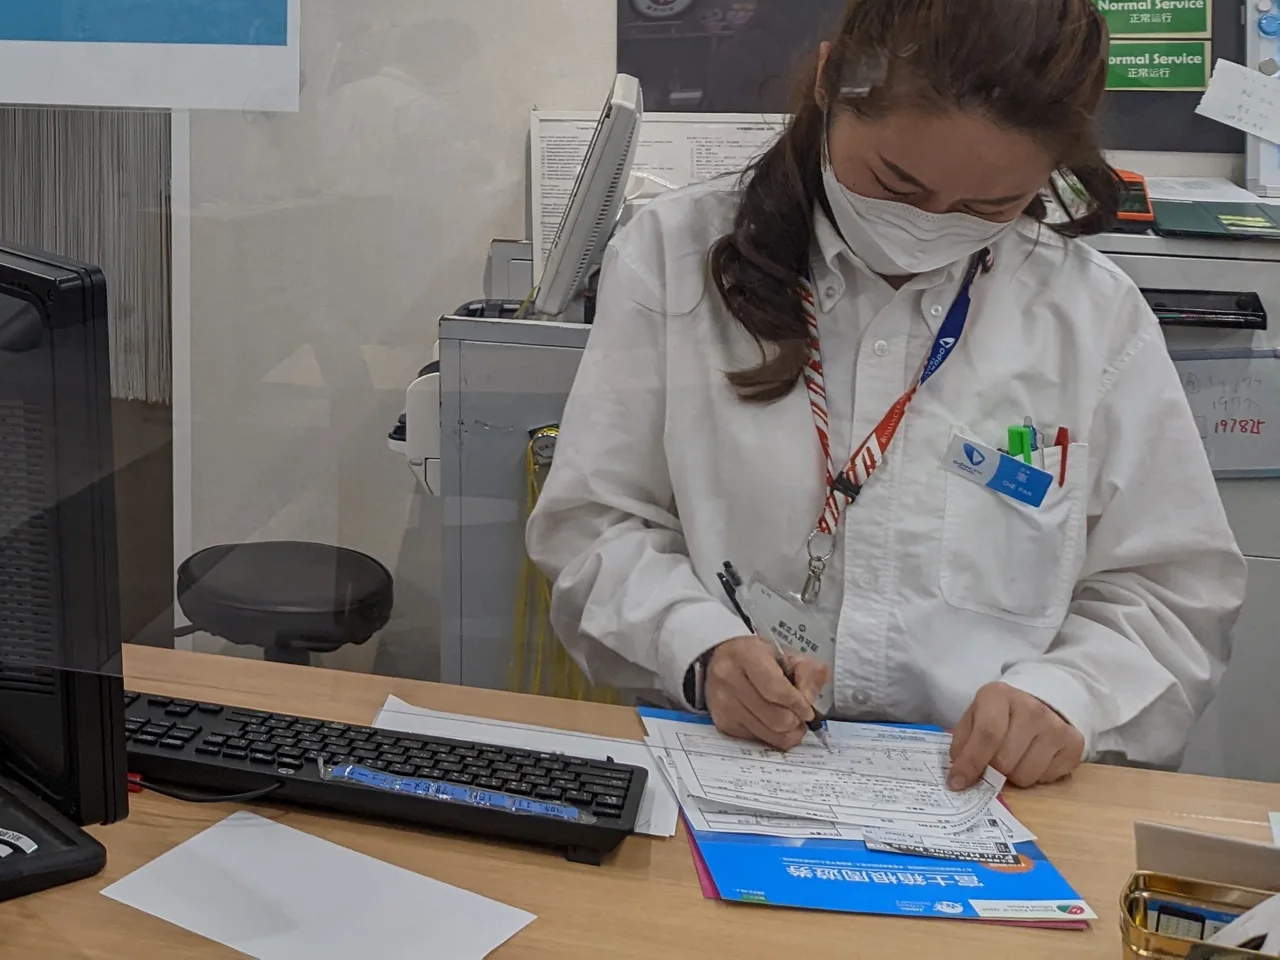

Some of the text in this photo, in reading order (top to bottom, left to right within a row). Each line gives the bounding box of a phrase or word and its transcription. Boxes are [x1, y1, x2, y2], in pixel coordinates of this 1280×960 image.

[1129, 13, 1172, 23] 正常运行
[1108, 53, 1202, 65] ormal Service
[1127, 68, 1170, 78] 正常运行
